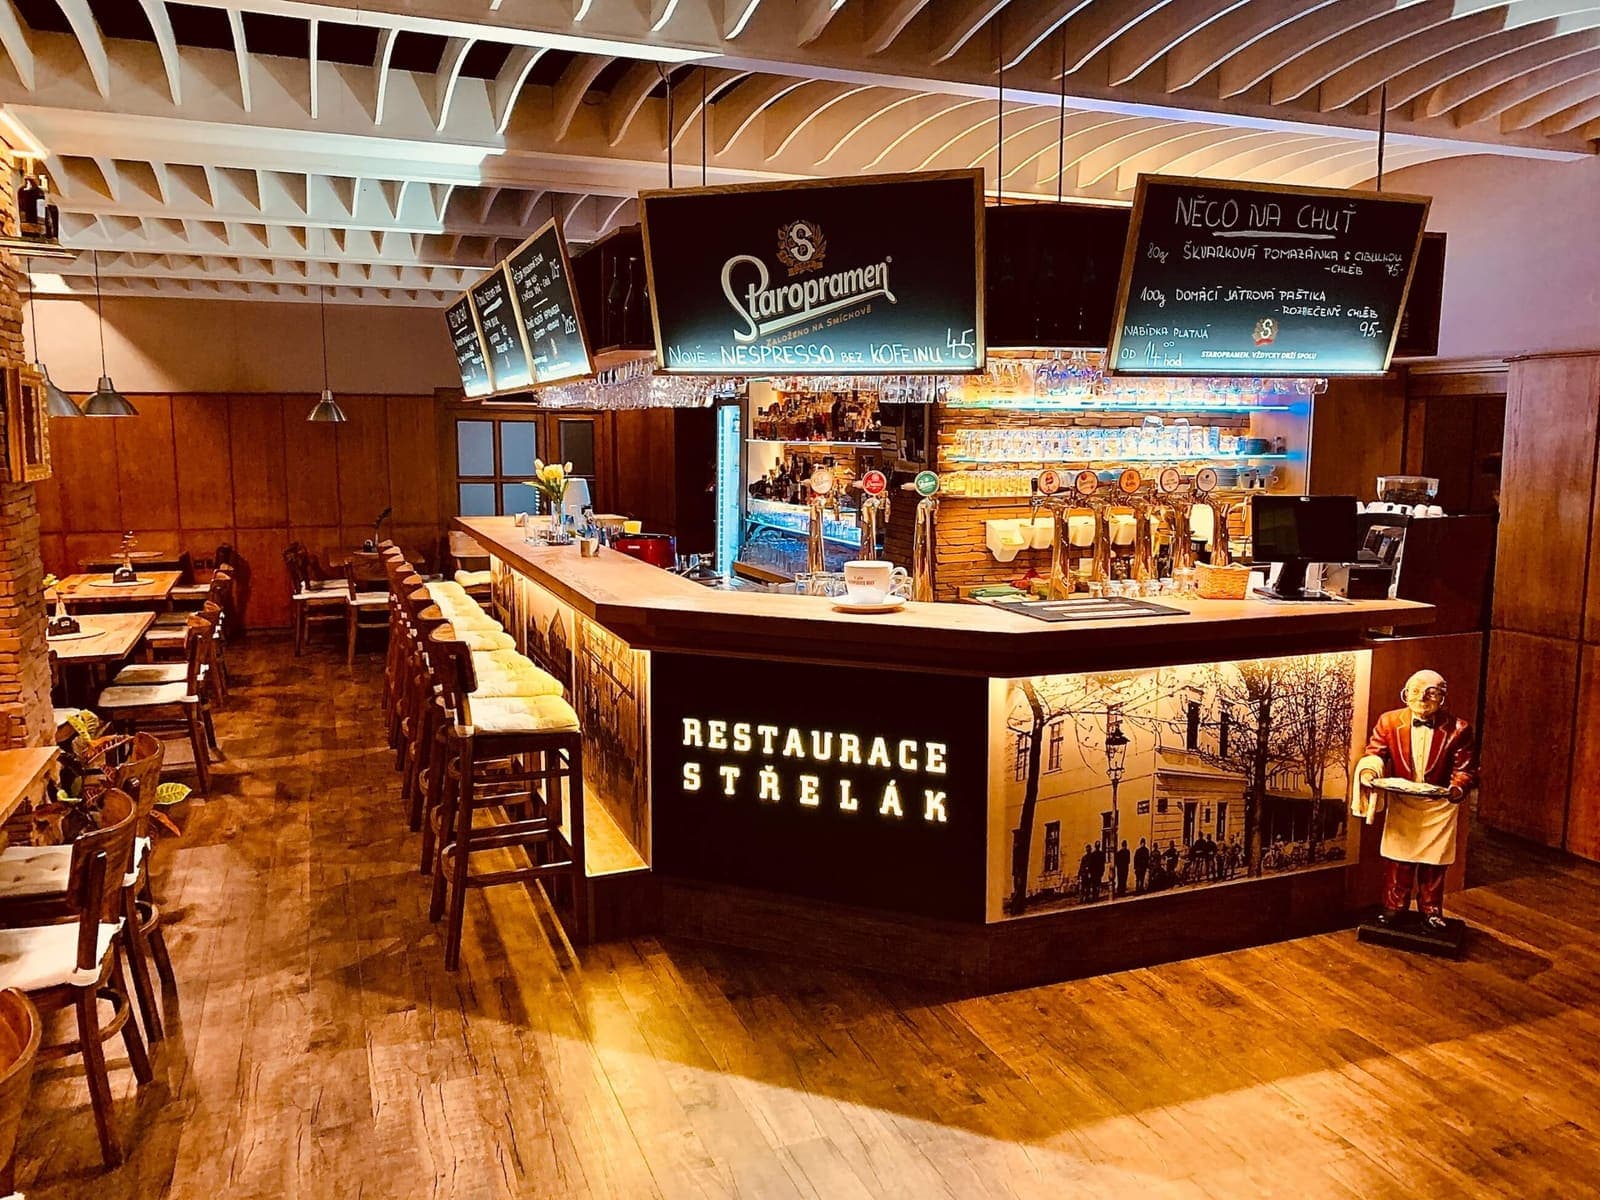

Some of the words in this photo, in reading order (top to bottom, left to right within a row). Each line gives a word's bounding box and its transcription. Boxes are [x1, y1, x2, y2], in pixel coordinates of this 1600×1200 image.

[1175, 194, 1239, 228] NĚCO
[1249, 203, 1281, 227] NA
[1297, 203, 1357, 233] CHUŤ
[1147, 242, 1169, 264] 80g
[1183, 240, 1259, 260] ŠKVARKOVÁ
[1264, 246, 1339, 261] POMAZÁNKA
[721, 255, 897, 343] Staropramen
[1140, 286, 1167, 308] 100g
[1175, 285, 1223, 302] DOMÁCÍ
[1224, 286, 1276, 302] JÁTROVÁ
[1279, 288, 1326, 302] PAŠTIKA
[1347, 307, 1378, 319] CHLÉB
[1124, 323, 1169, 337] NABÍDKA
[1173, 324, 1211, 339] PLATNÁ
[720, 344, 834, 365] NESPRESSO
[841, 351, 864, 363] BEZ
[1121, 347, 1137, 359] OD
[682, 717, 948, 775] RESTAURACE
[682, 762, 948, 824] STŘELÁK
